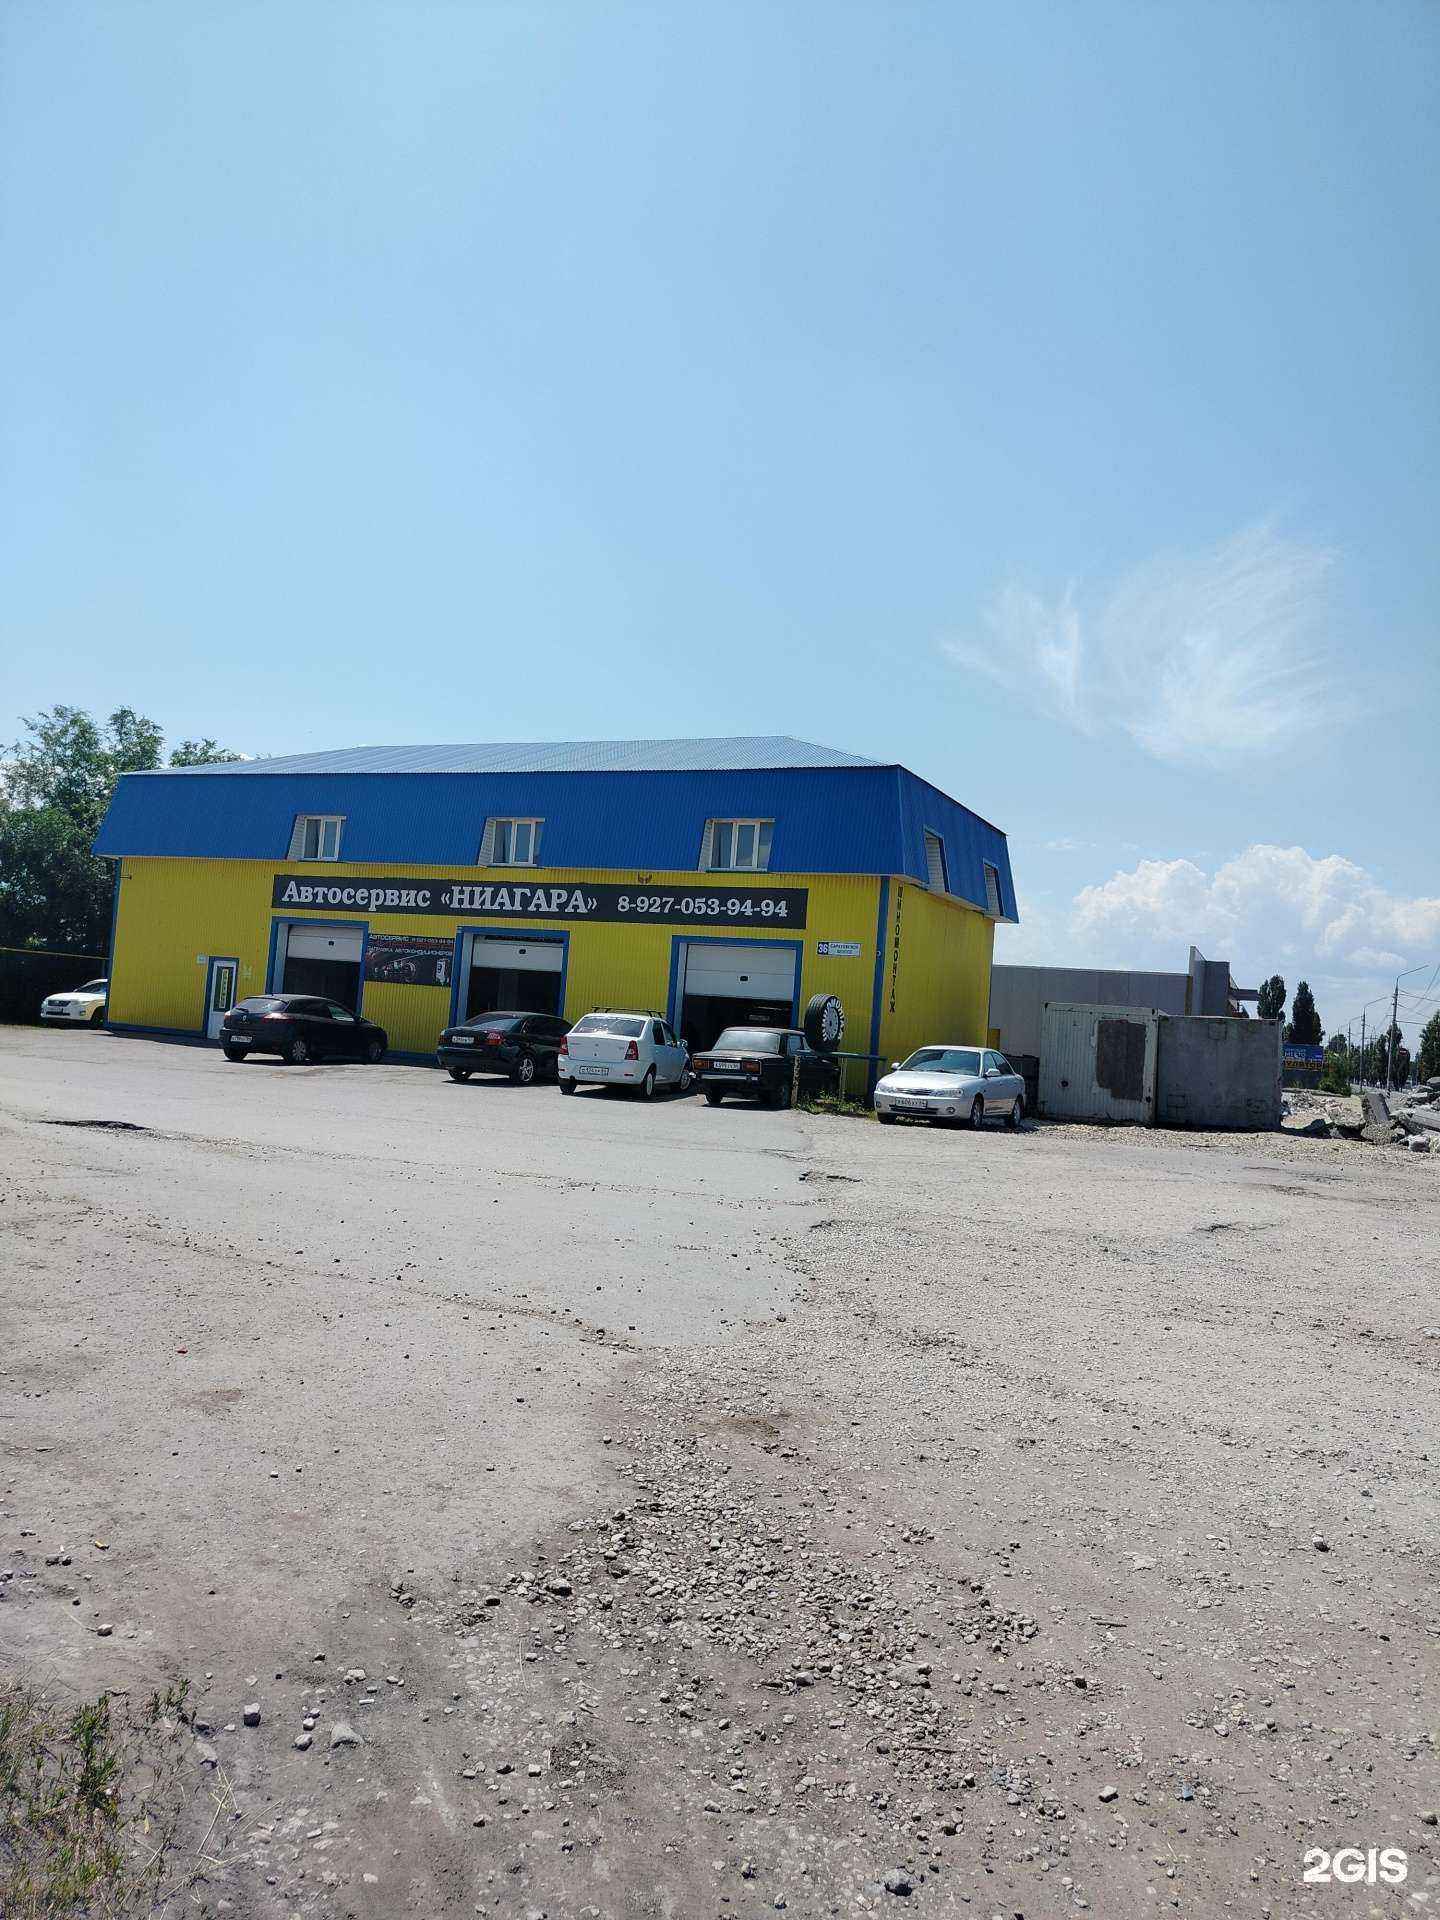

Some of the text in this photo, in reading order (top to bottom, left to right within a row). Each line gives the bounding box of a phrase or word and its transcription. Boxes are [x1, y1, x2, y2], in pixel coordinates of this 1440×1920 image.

[281, 880, 788, 918] Автосервис «НИАГАРА» 8-927-053-94-94
[818, 943, 828, 953] 36
